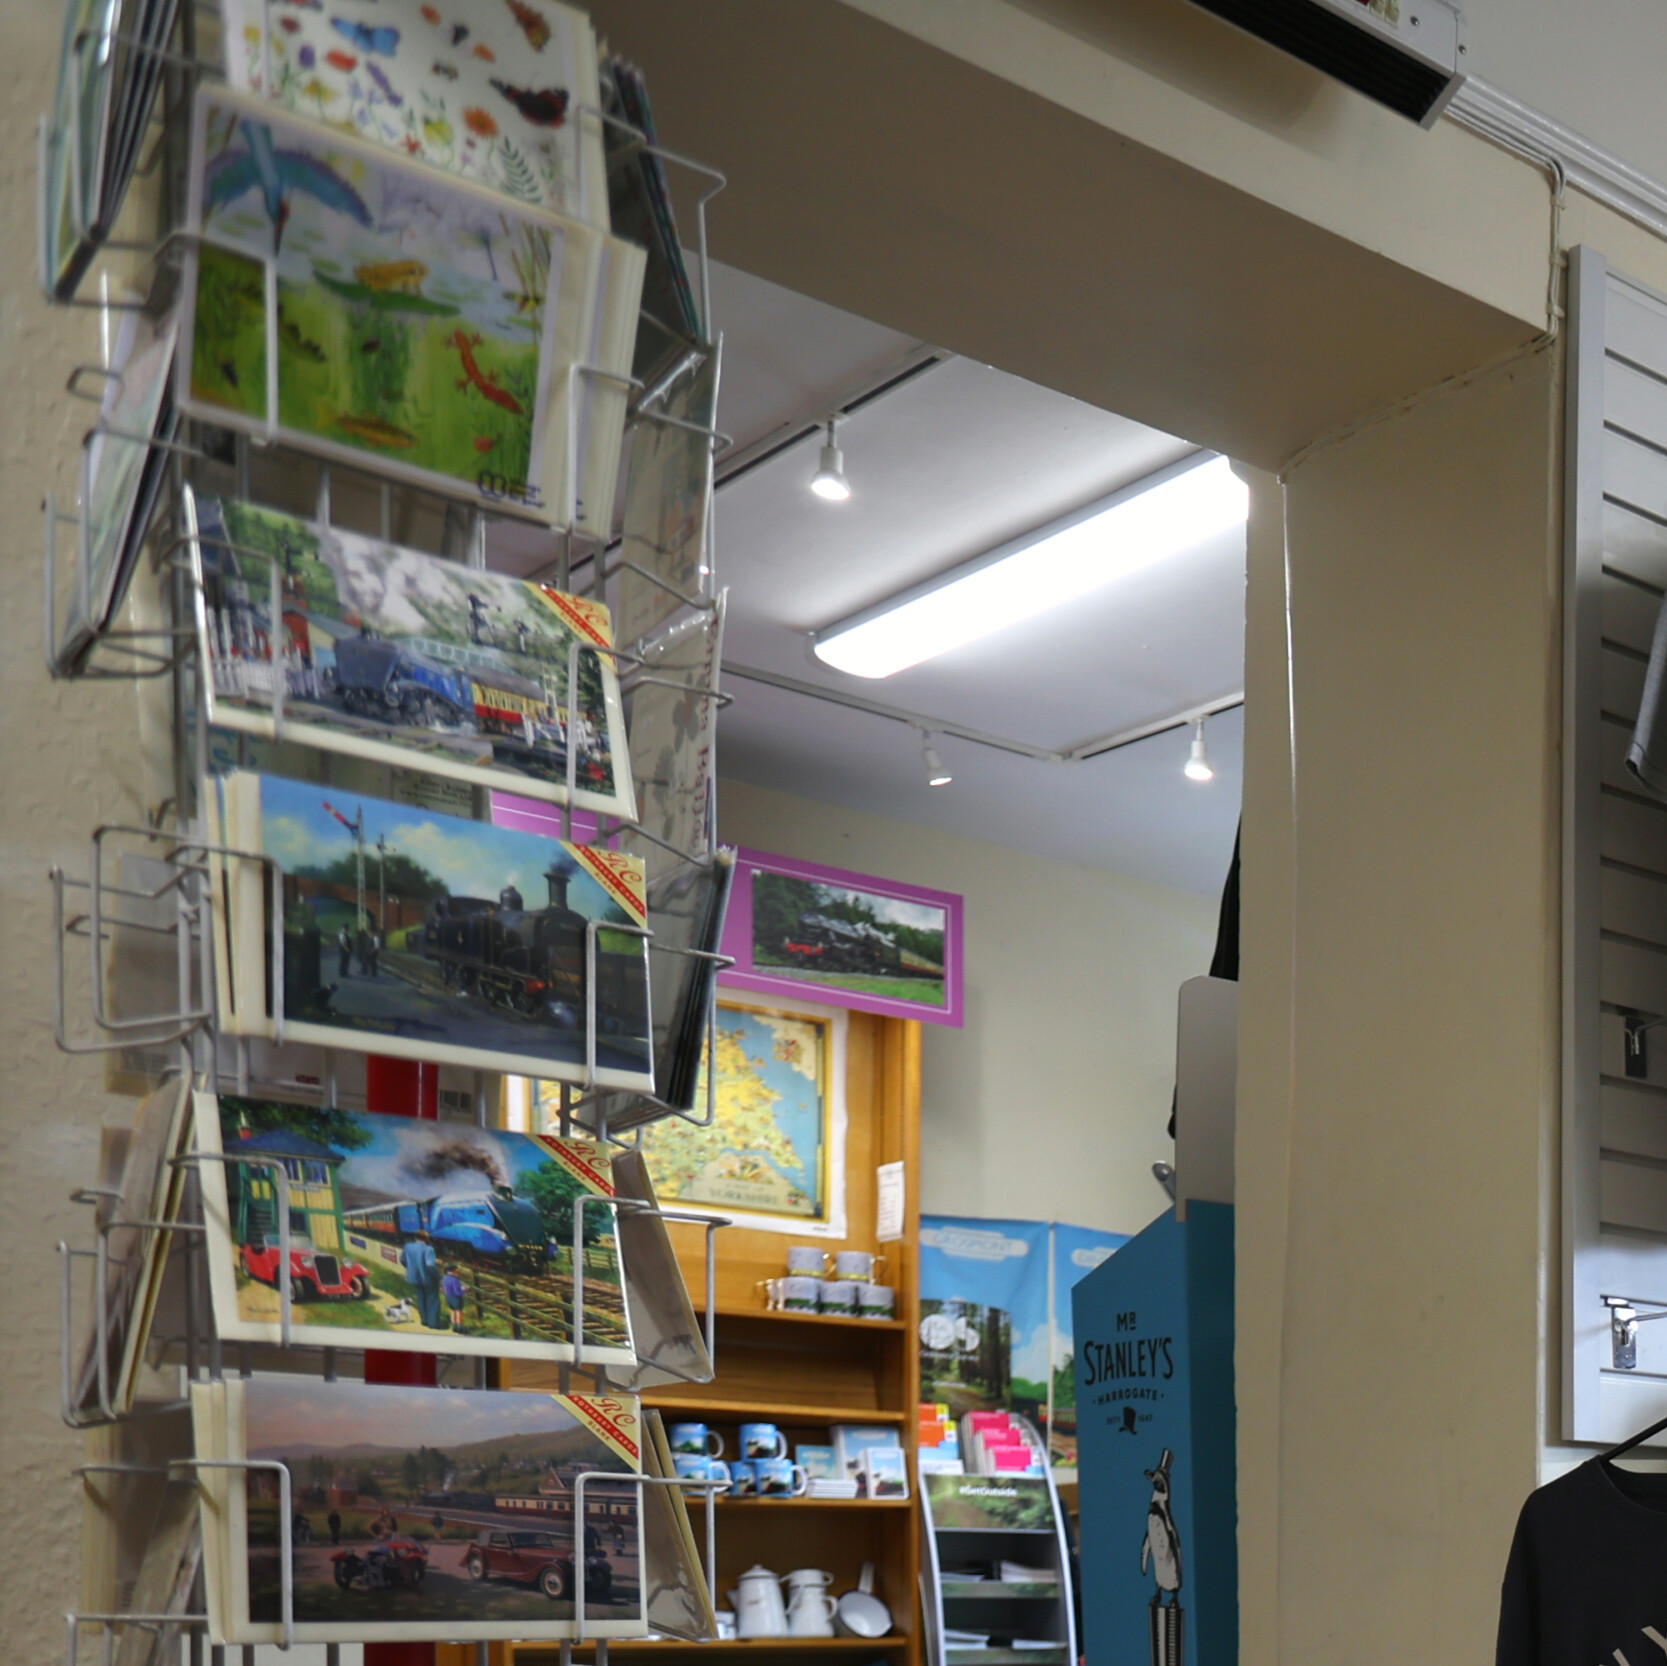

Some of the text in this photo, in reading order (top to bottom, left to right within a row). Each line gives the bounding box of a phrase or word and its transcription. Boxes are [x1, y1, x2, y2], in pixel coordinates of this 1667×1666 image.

[564, 1141, 611, 1169] RC
[1084, 1336, 1174, 1386] STANLEY'S
[1098, 1388, 1157, 1405] HARROGATE
[573, 1396, 638, 1453] ROTHBURY CARDS
[591, 1397, 636, 1427] RC
[587, 1420, 611, 1442] BLANK
[959, 1485, 1018, 1497] #GetOutside
